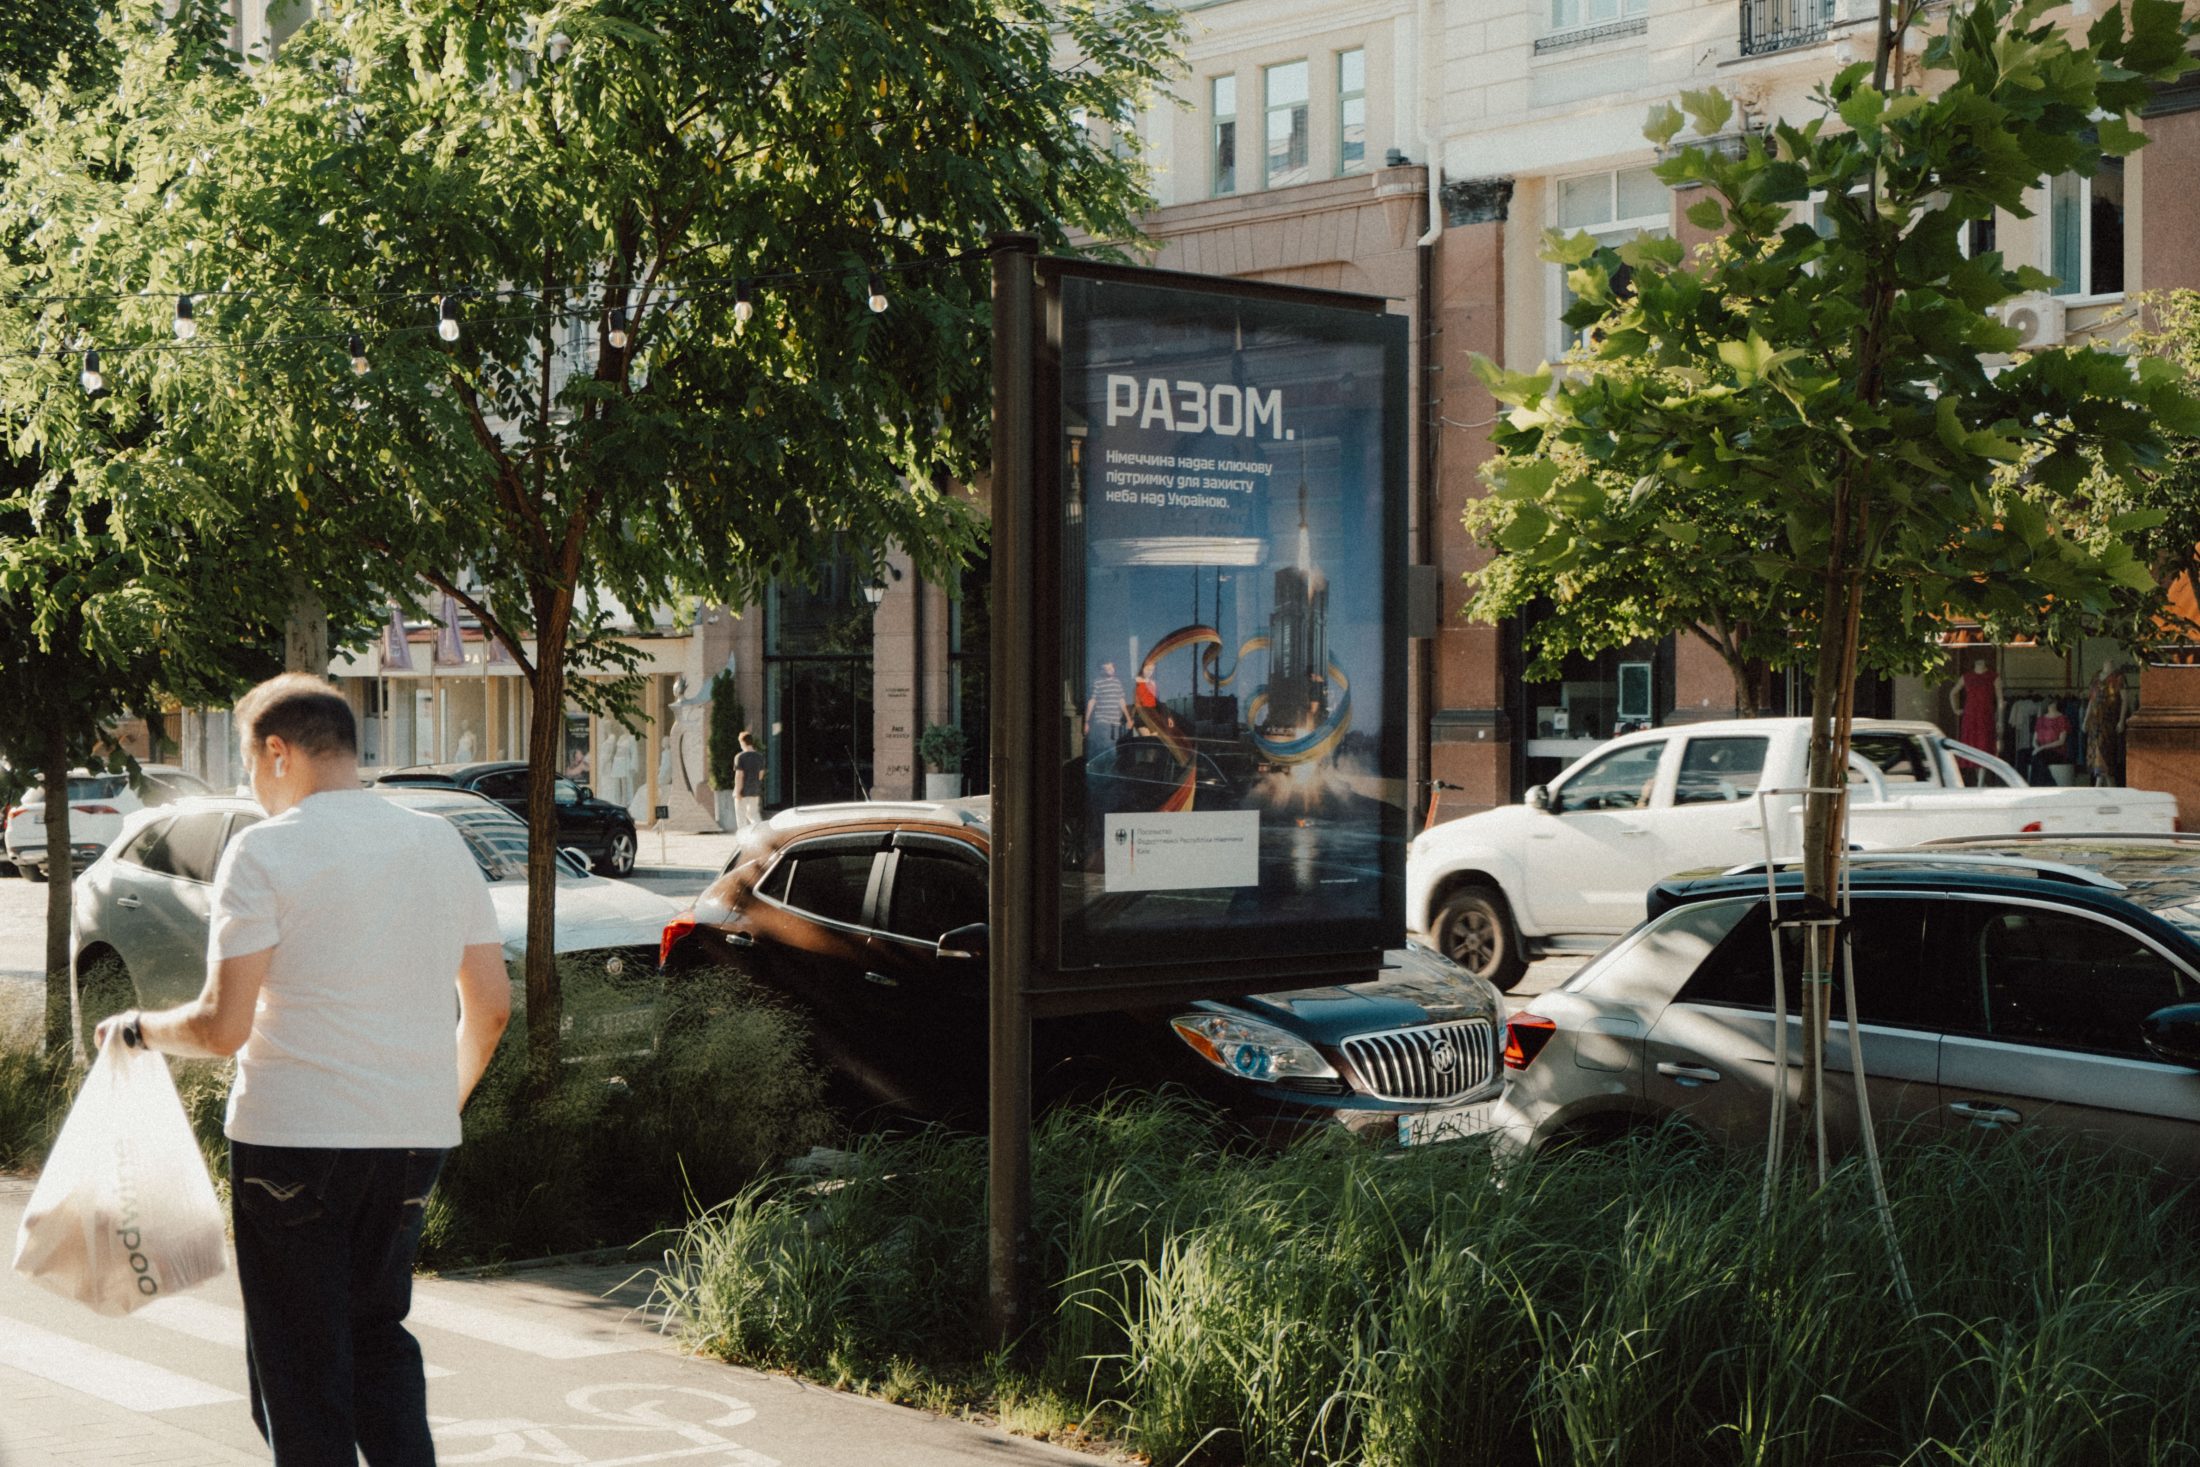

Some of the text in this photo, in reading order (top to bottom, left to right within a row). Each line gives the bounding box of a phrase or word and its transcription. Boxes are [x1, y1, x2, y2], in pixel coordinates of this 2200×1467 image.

[1106, 374, 1295, 441] РАЗОМ.
[1106, 449, 1273, 476] Німеччина надає ключову
[1106, 469, 1254, 493] підтримку для захисту
[1106, 489, 1231, 509] неба над Україною.
[112, 1137, 158, 1297] oodwine
